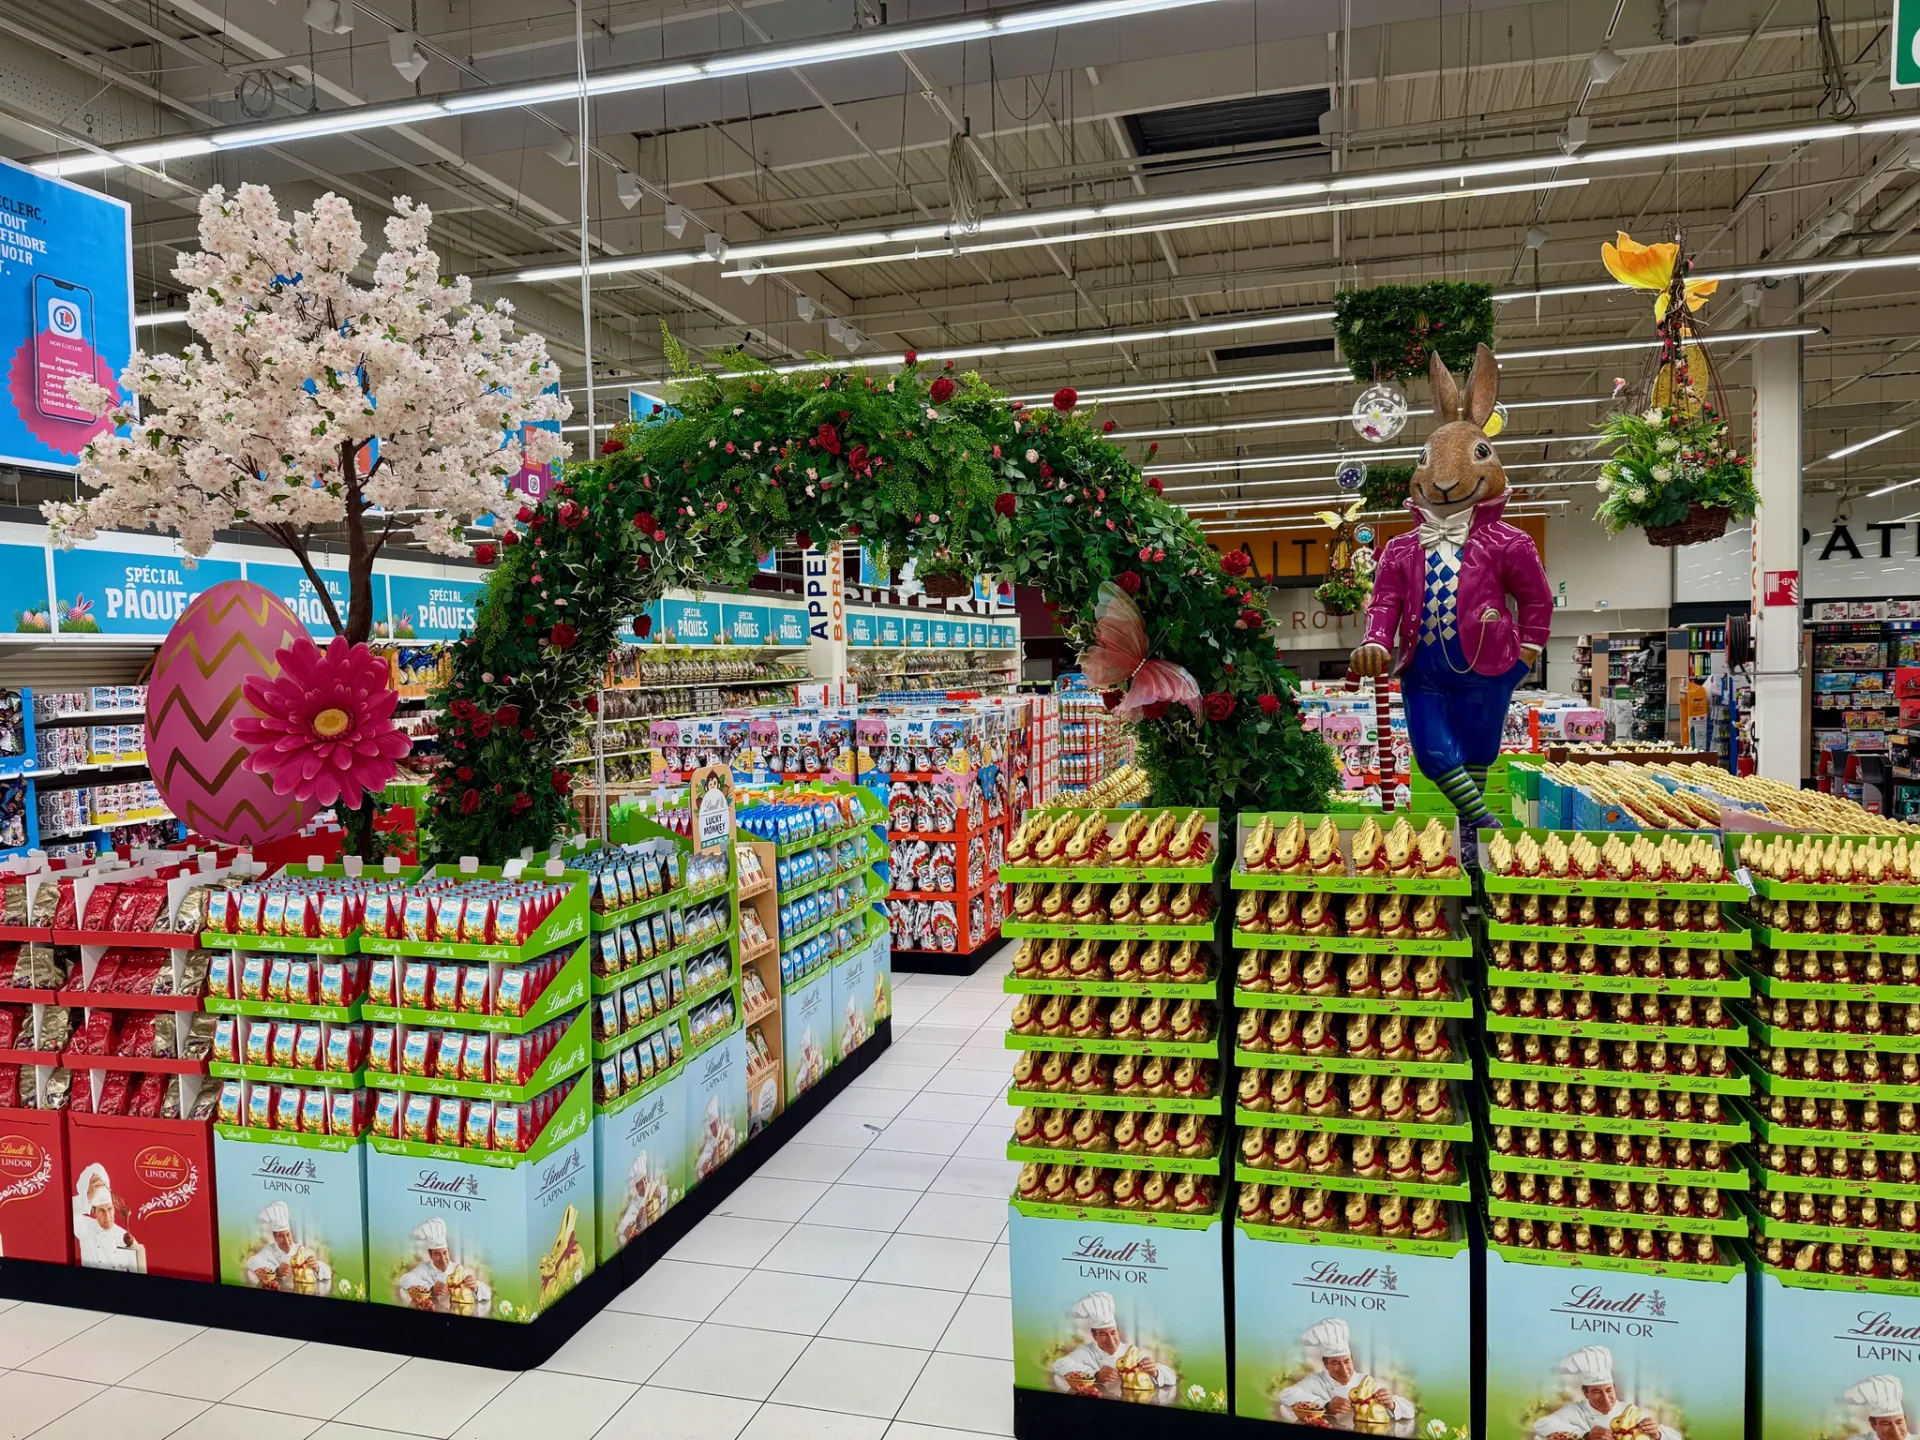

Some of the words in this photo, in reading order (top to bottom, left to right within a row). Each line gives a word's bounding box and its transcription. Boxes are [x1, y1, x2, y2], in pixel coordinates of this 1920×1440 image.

[55, 356, 78, 367] Promos
[125, 565, 183, 585] SPÉCIAL
[105, 583, 201, 620] PÂQUE
[429, 588, 462, 602] SPÉCIAL
[418, 601, 476, 629] PÂQUES
[678, 617, 708, 637] PÂQUES
[733, 619, 759, 638] PÂQUES
[780, 622, 802, 639] PÂQUES
[704, 822, 725, 835] MONKEY
[706, 814, 722, 825] LUCKY
[544, 920, 574, 945] Lindt
[212, 938, 231, 947] Lindt
[259, 940, 280, 949] Lindt
[307, 942, 327, 951] Lindt
[372, 942, 394, 952] Lindt
[424, 945, 447, 955] Lindt
[478, 948, 501, 958] Lindt
[545, 987, 574, 1014] Lindt
[216, 1003, 236, 1012] Lindt
[262, 1006, 283, 1015] Lindt
[310, 1010, 331, 1019] Lindt
[373, 1010, 396, 1020] Lindt
[425, 1014, 449, 1024] Lindt
[479, 1020, 503, 1030] Lindt
[220, 1067, 241, 1076] Lindt
[267, 1071, 288, 1080] Lindt
[315, 1075, 336, 1084] Lindt
[546, 1053, 575, 1081] Lindt
[376, 1076, 399, 1087] Lindt
[429, 1083, 451, 1093] Lindt
[480, 1088, 504, 1098] Lindt
[225, 1129, 245, 1138] Lindt
[271, 1133, 292, 1142] Lindt
[319, 1139, 340, 1148] Lindt
[548, 1118, 577, 1147] Lindt
[632, 1128, 650, 1147] LAPIN
[649, 1122, 660, 1134] OR
[1, 1158, 32, 1168] LINDOR
[143, 1154, 171, 1166] Lindt
[378, 1141, 401, 1152] Lindt
[430, 1148, 452, 1159] Lindt
[483, 1154, 506, 1165] Lindt
[145, 1170, 178, 1179] LINDOR
[258, 1154, 304, 1177] Lindt
[263, 1179, 292, 1193] LAPIN
[294, 1182, 311, 1195] OR
[414, 1169, 465, 1192] Lindt
[543, 1185, 563, 1207] LAPIN
[564, 1177, 576, 1191] OR
[420, 1194, 451, 1210] LAPIN
[453, 1198, 471, 1212] OR
[1071, 1235, 1139, 1261] Lindt
[1079, 1265, 1120, 1282] LAPIN
[1124, 1270, 1148, 1284] OR
[1302, 1261, 1377, 1288] Lindt
[1310, 1291, 1356, 1308] LAPIN
[1361, 1296, 1386, 1311] OR
[1562, 1285, 1645, 1314] Lindt
[1570, 1318, 1620, 1334] LAPIN
[1625, 1322, 1653, 1338] OR
[1857, 1345, 1911, 1363] LAPIN
